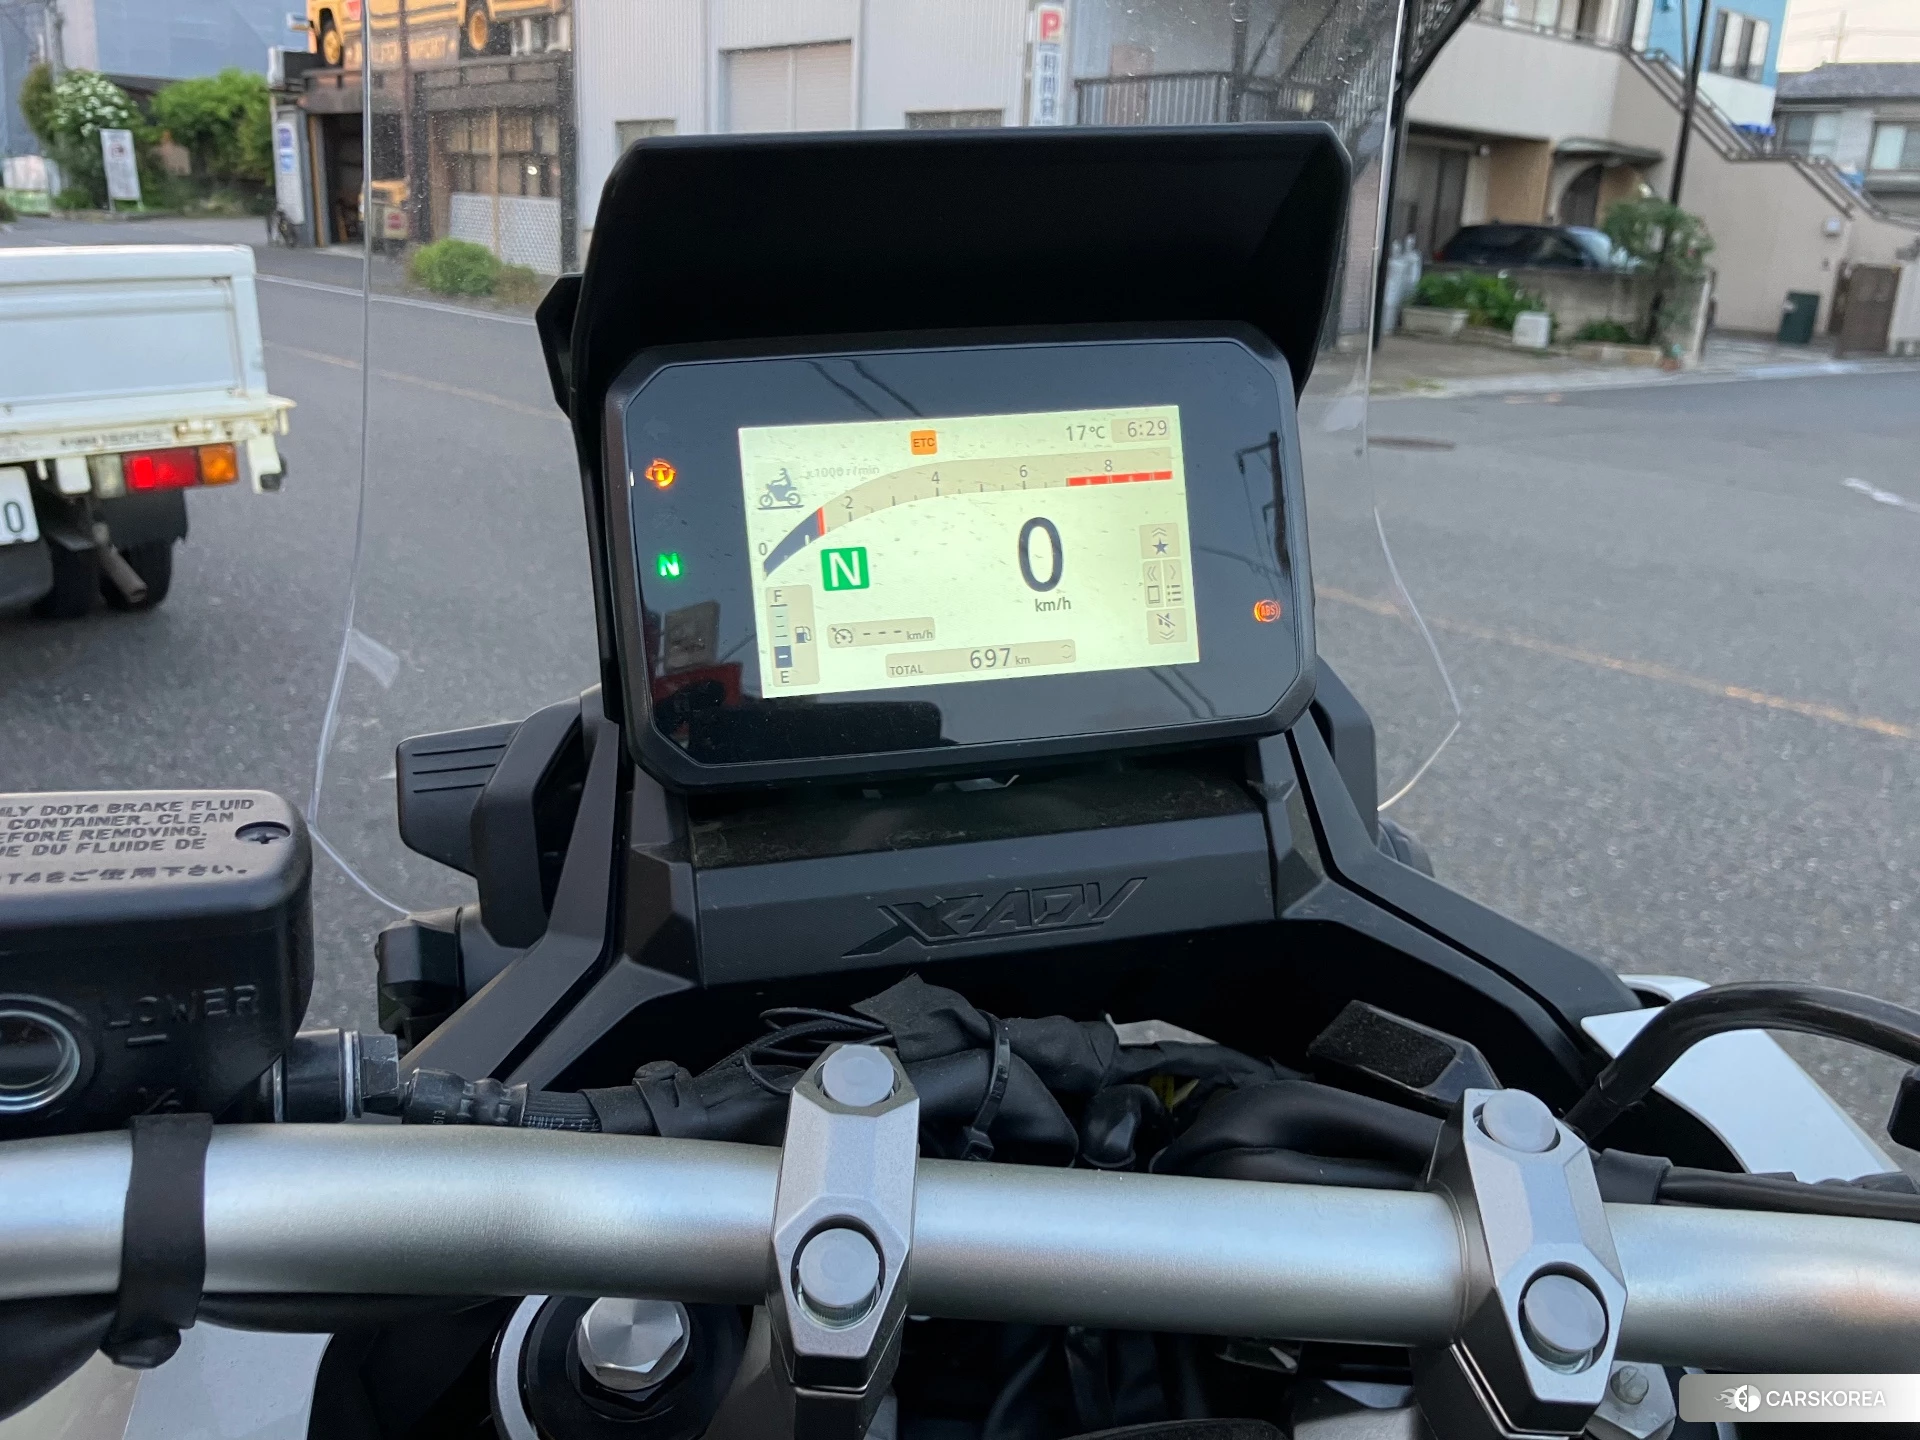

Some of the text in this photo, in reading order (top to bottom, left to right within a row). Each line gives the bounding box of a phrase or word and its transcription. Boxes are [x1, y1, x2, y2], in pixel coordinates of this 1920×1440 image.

[1127, 419, 1167, 437] 6:29
[913, 437, 936, 448] ETC
[1019, 464, 1029, 478] 6
[1103, 459, 1113, 472] 8
[931, 471, 941, 484] 4
[843, 495, 854, 509] 2
[758, 542, 768, 556] 0
[1017, 516, 1064, 593] 0
[659, 553, 681, 577] N
[828, 550, 862, 588] N
[773, 590, 782, 603] F
[1034, 597, 1072, 612] km/h
[905, 630, 934, 640] km/h
[889, 647, 1031, 676] TOTAL 697 km
[780, 671, 790, 684] E
[40, 804, 99, 816] DOT4
[107, 801, 184, 814] BRAKE
[191, 799, 255, 811] FLUID
[8, 812, 234, 830] CONTAINER. CLEAN
[79, 825, 208, 841] REMOVING.
[32, 843, 68, 856] DU
[75, 839, 166, 854] FLUIDE
[175, 838, 207, 850] DE
